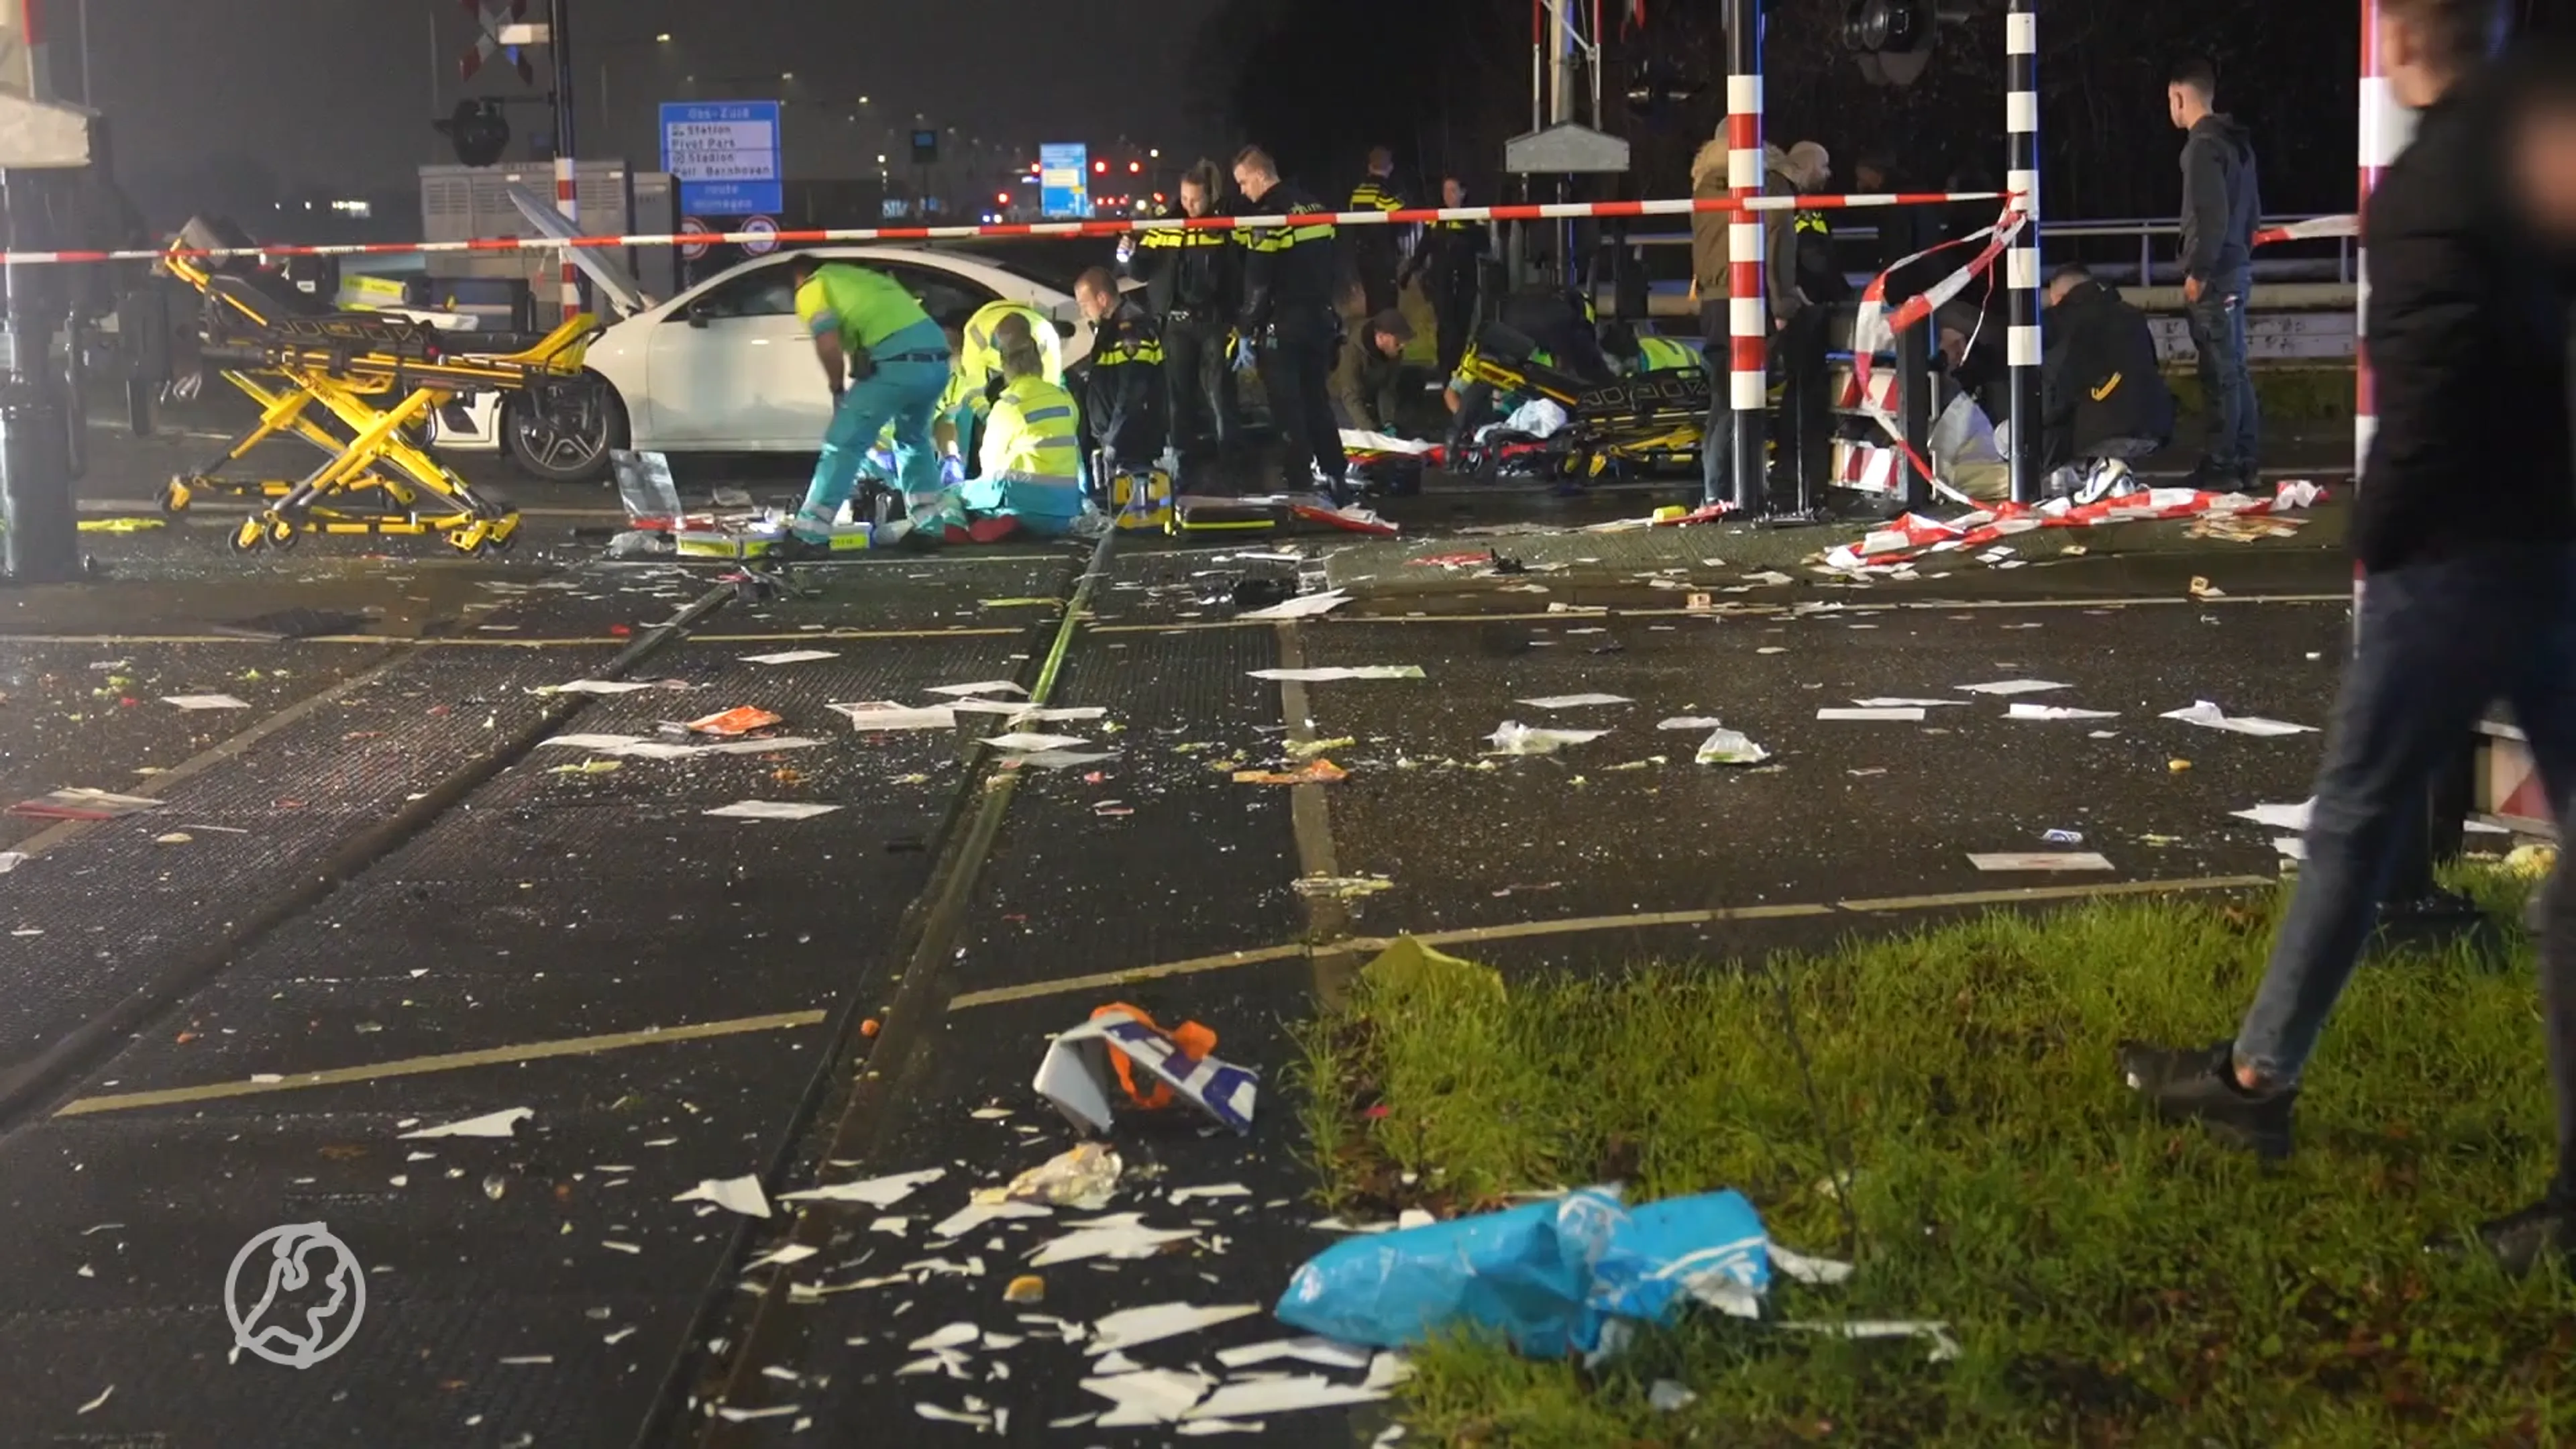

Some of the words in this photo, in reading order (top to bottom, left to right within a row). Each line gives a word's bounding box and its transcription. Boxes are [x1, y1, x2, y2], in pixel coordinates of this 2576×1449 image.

[687, 125, 731, 135] Station
[672, 139, 704, 150] Pivot
[708, 138, 736, 148] Park
[688, 153, 735, 163] Stadion
